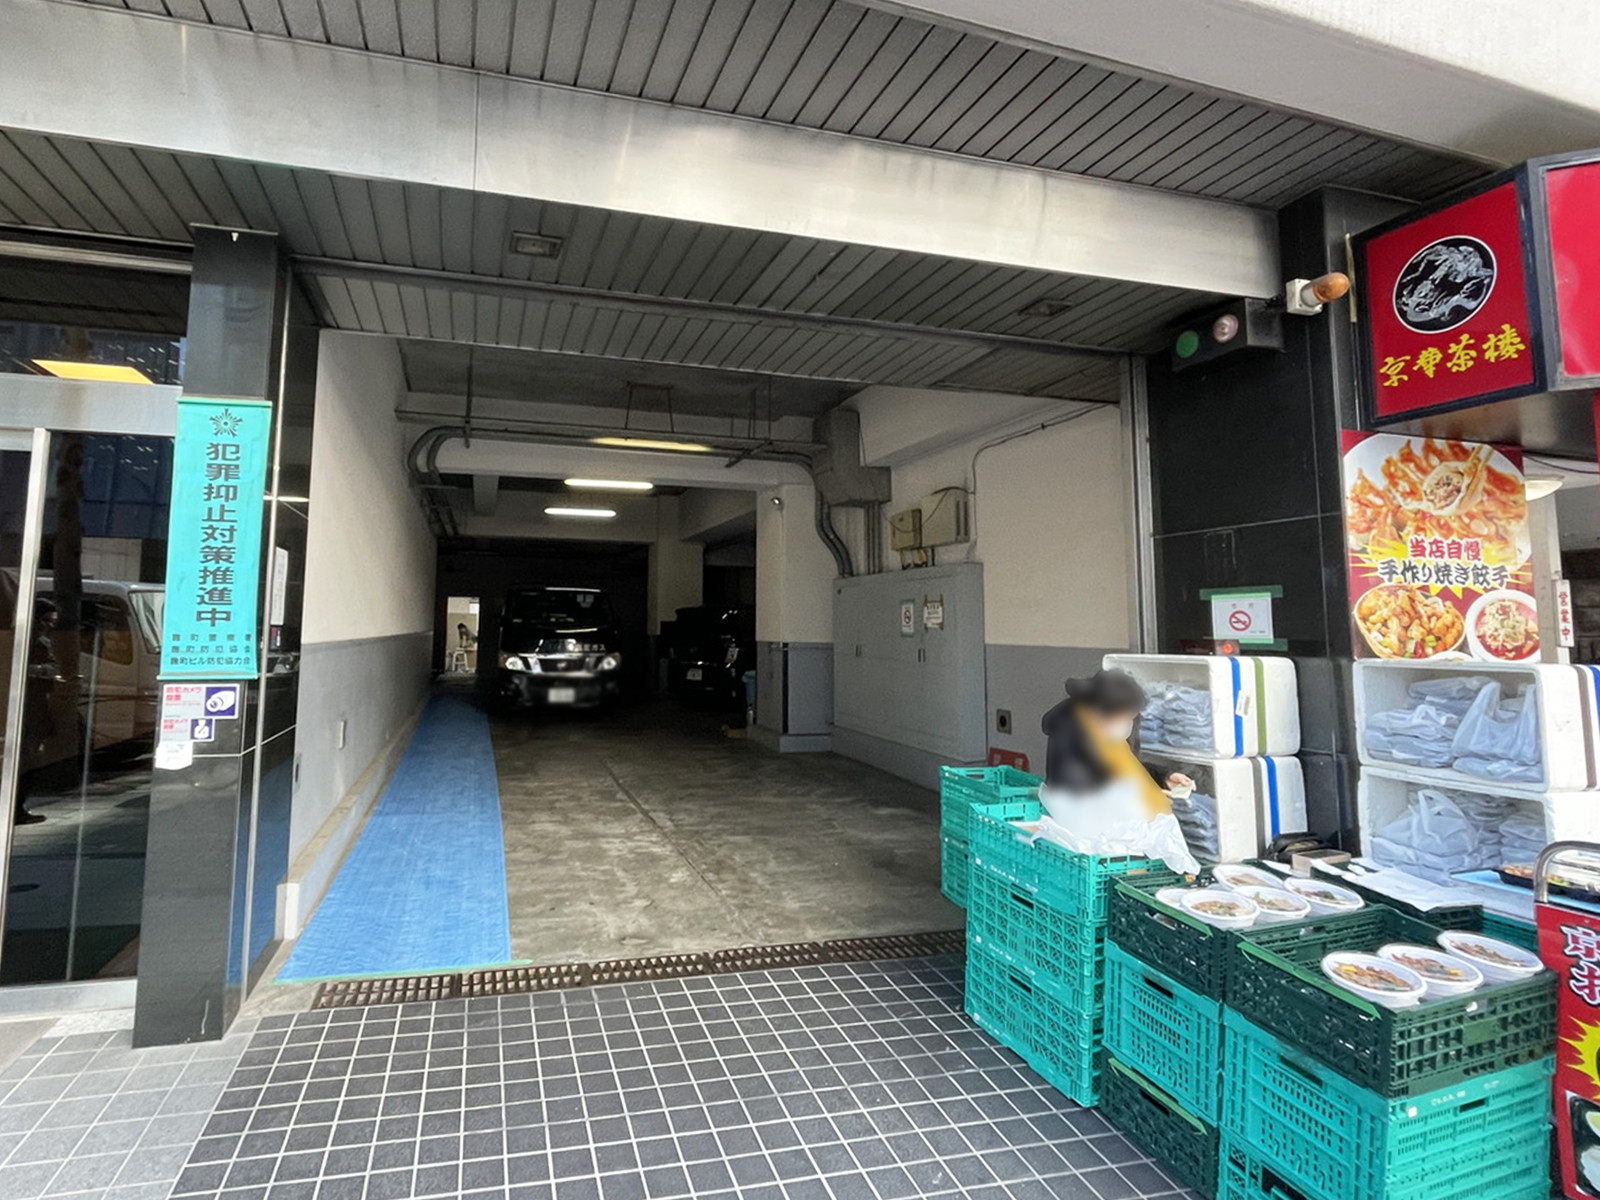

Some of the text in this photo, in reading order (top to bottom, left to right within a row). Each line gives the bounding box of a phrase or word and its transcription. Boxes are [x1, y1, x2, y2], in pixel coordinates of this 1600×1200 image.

[197, 443, 240, 626] 犯罪抑止対策推進中
[1410, 537, 1481, 561] 当店自慢
[1380, 559, 1510, 588] 手作り焼き餃子
